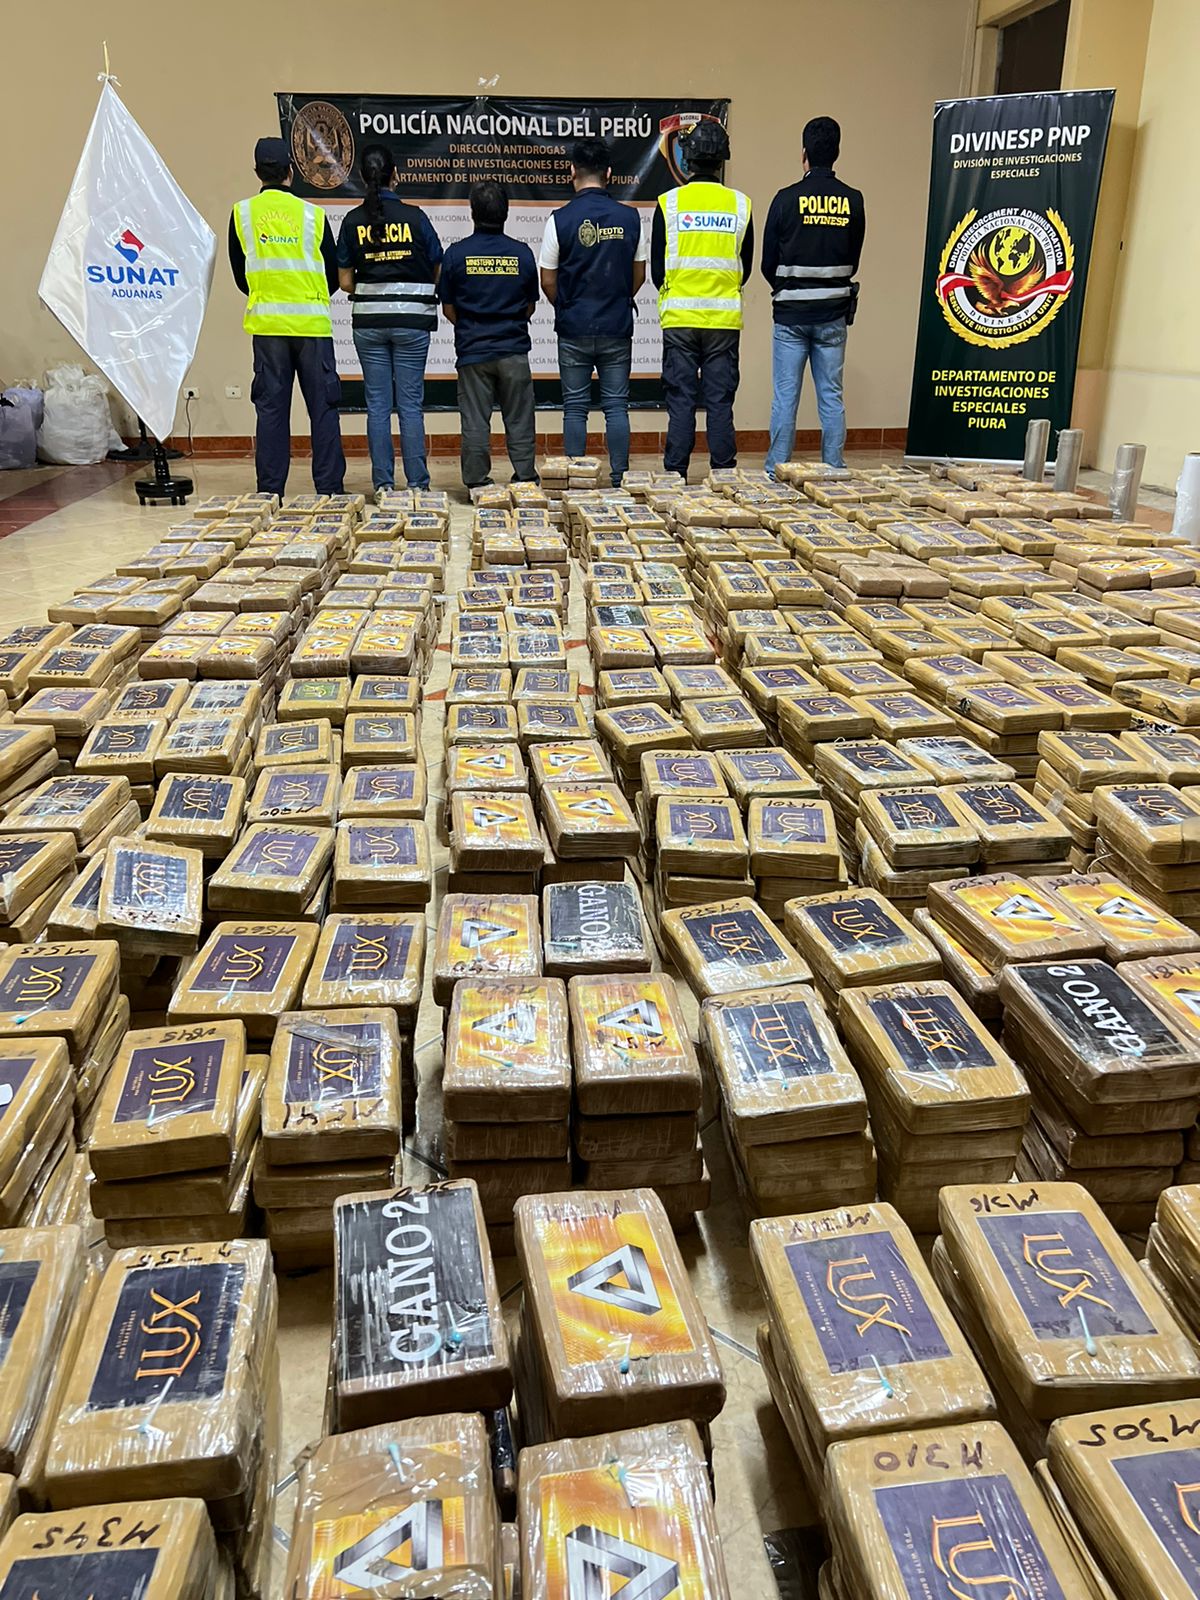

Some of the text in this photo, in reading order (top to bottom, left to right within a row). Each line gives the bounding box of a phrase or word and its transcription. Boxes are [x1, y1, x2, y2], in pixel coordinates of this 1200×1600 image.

[360, 110, 441, 135] POLICÍA
[447, 114, 552, 137] NACIONAL
[557, 116, 595, 138] DEL
[601, 114, 651, 138] PERÚ
[450, 142, 566, 155] DIRECCIÓN ANTIDROGAS
[950, 125, 1091, 154] DIVINESP PNP
[407, 157, 450, 168] DIVISIÓN
[452, 158, 466, 169] DE
[467, 159, 552, 170] INVESTIGACIONES
[953, 153, 1082, 169] DIVISIÓN DE INVESTIGACIONES
[990, 168, 1040, 180] ESPECIALES
[396, 173, 452, 183] ARTAMENTO
[455, 173, 467, 183] DE
[612, 175, 640, 185] PIURA
[516, 214, 542, 223] POLICÍA
[799, 195, 850, 215] POLICIA
[357, 223, 412, 245] PICIA
[694, 216, 733, 229] SUNAT
[803, 214, 849, 227] DIVINESP
[983, 217, 1026, 231] NACIONAL
[1020, 208, 1064, 266] ADMINISTRATION
[87, 265, 180, 286] SUNAT
[111, 288, 163, 299] ADUANAS
[969, 309, 1031, 325] DIVINESP
[974, 314, 1038, 335] INVESTIGATIVE
[1037, 294, 1055, 315] UNIT
[931, 370, 1056, 383] DEPARTAMENTO DE
[934, 386, 1050, 399] INVESTIGACIONES
[952, 402, 1027, 414] ESPECIALES
[968, 417, 1007, 429] PIURA
[855, 750, 897, 768] LUX
[684, 809, 718, 835] LUX
[777, 812, 810, 836] LUX
[260, 839, 297, 869] LUX
[364, 832, 400, 859] LUX
[577, 884, 611, 936] GANO
[831, 907, 889, 941] LUX
[350, 933, 389, 971] LUX
[709, 920, 765, 956] LUX
[220, 944, 266, 982] LUX
[15, 964, 66, 1003] LUX
[1046, 964, 1148, 1057] GANO 2
[751, 1016, 807, 1064] LUX
[902, 1007, 968, 1056] LUX
[148, 1056, 195, 1106] LUX
[383, 1195, 443, 1362] GANO 2
[1022, 1231, 1116, 1309] LUX
[826, 1253, 912, 1338] LUX
[135, 1288, 202, 1381] LUX
[1078, 1414, 1200, 1447] M305
[873, 1441, 983, 1471] M310
[33, 1516, 160, 1550] M345
[911, 1552, 925, 1575] WITH
[919, 1577, 933, 1600] SMAR
[1026, 1552, 1048, 1591] EDITABLE
